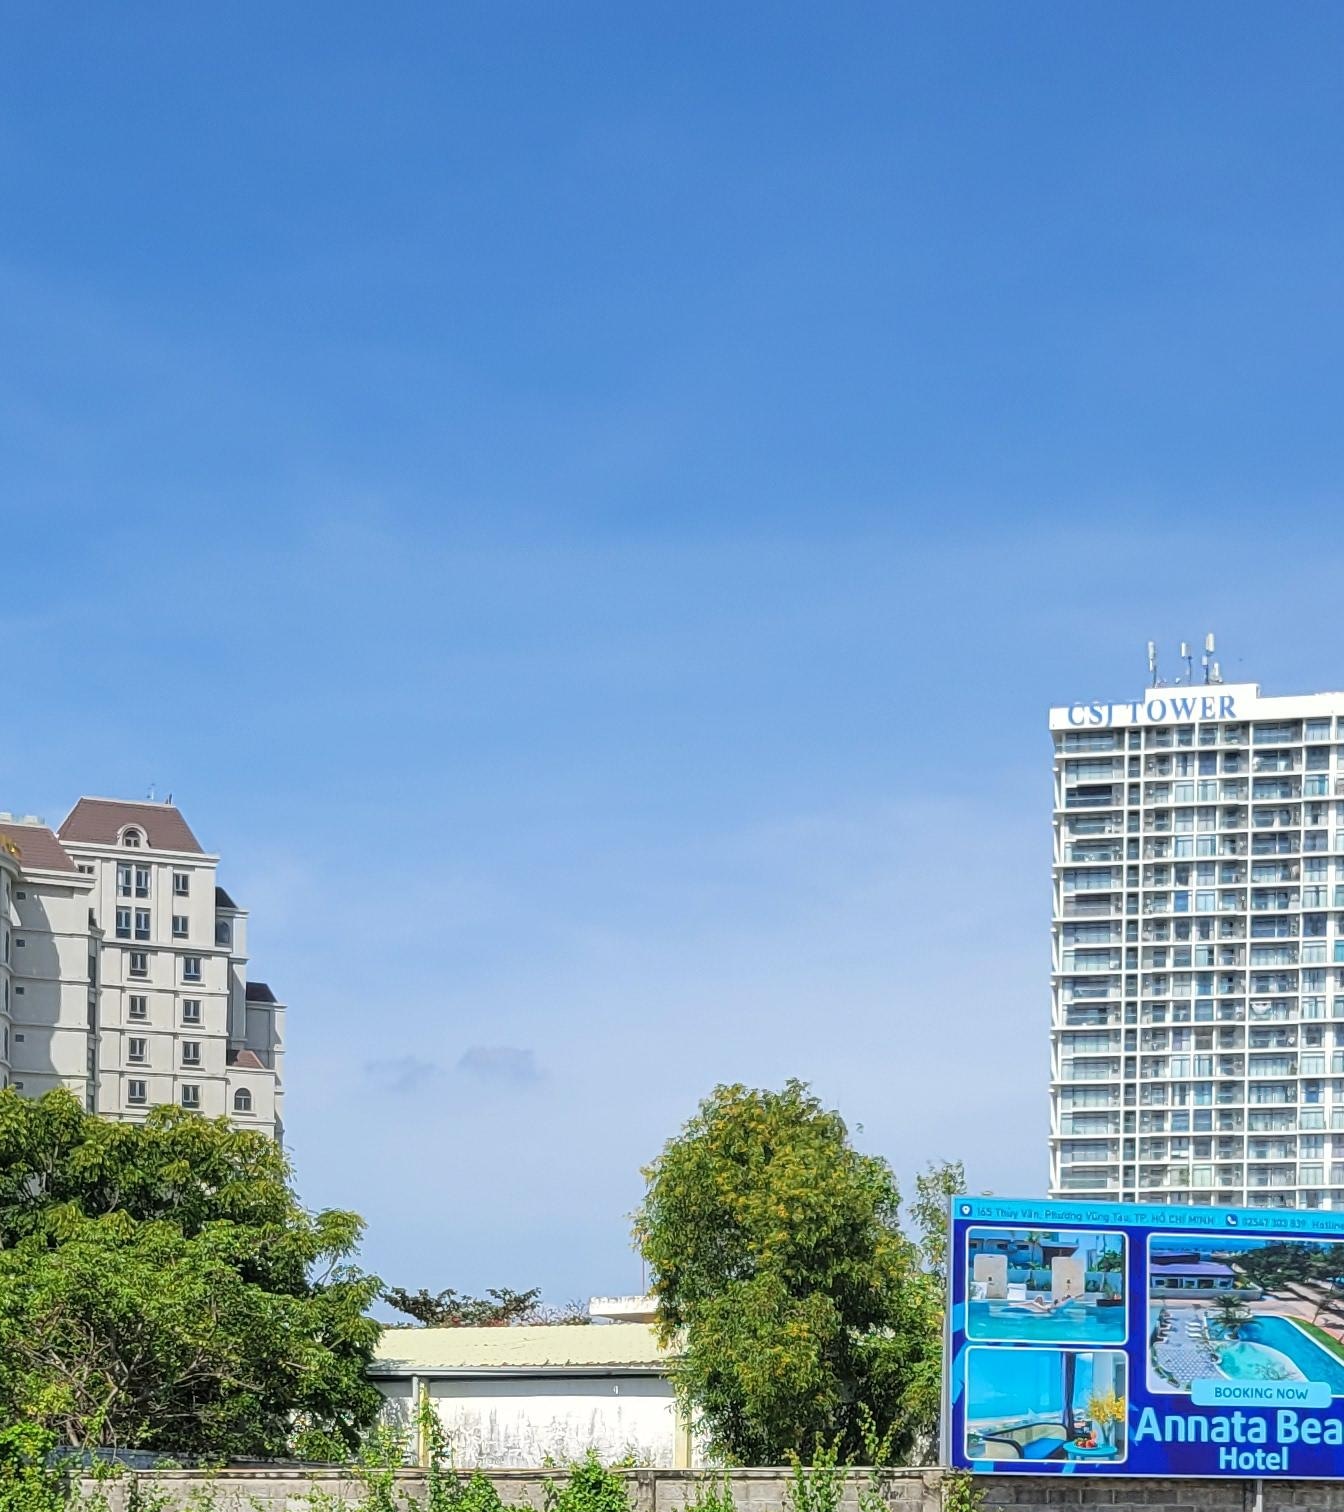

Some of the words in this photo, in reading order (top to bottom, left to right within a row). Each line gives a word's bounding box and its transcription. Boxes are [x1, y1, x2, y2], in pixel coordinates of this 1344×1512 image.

[1067, 701, 1113, 727] CSJ
[1126, 695, 1237, 724] TOWER
[1214, 1387, 1273, 1400] BOOKING
[1276, 1388, 1309, 1400] NOW
[1135, 1406, 1267, 1443] Annata
[1219, 1447, 1289, 1470] Hotel
